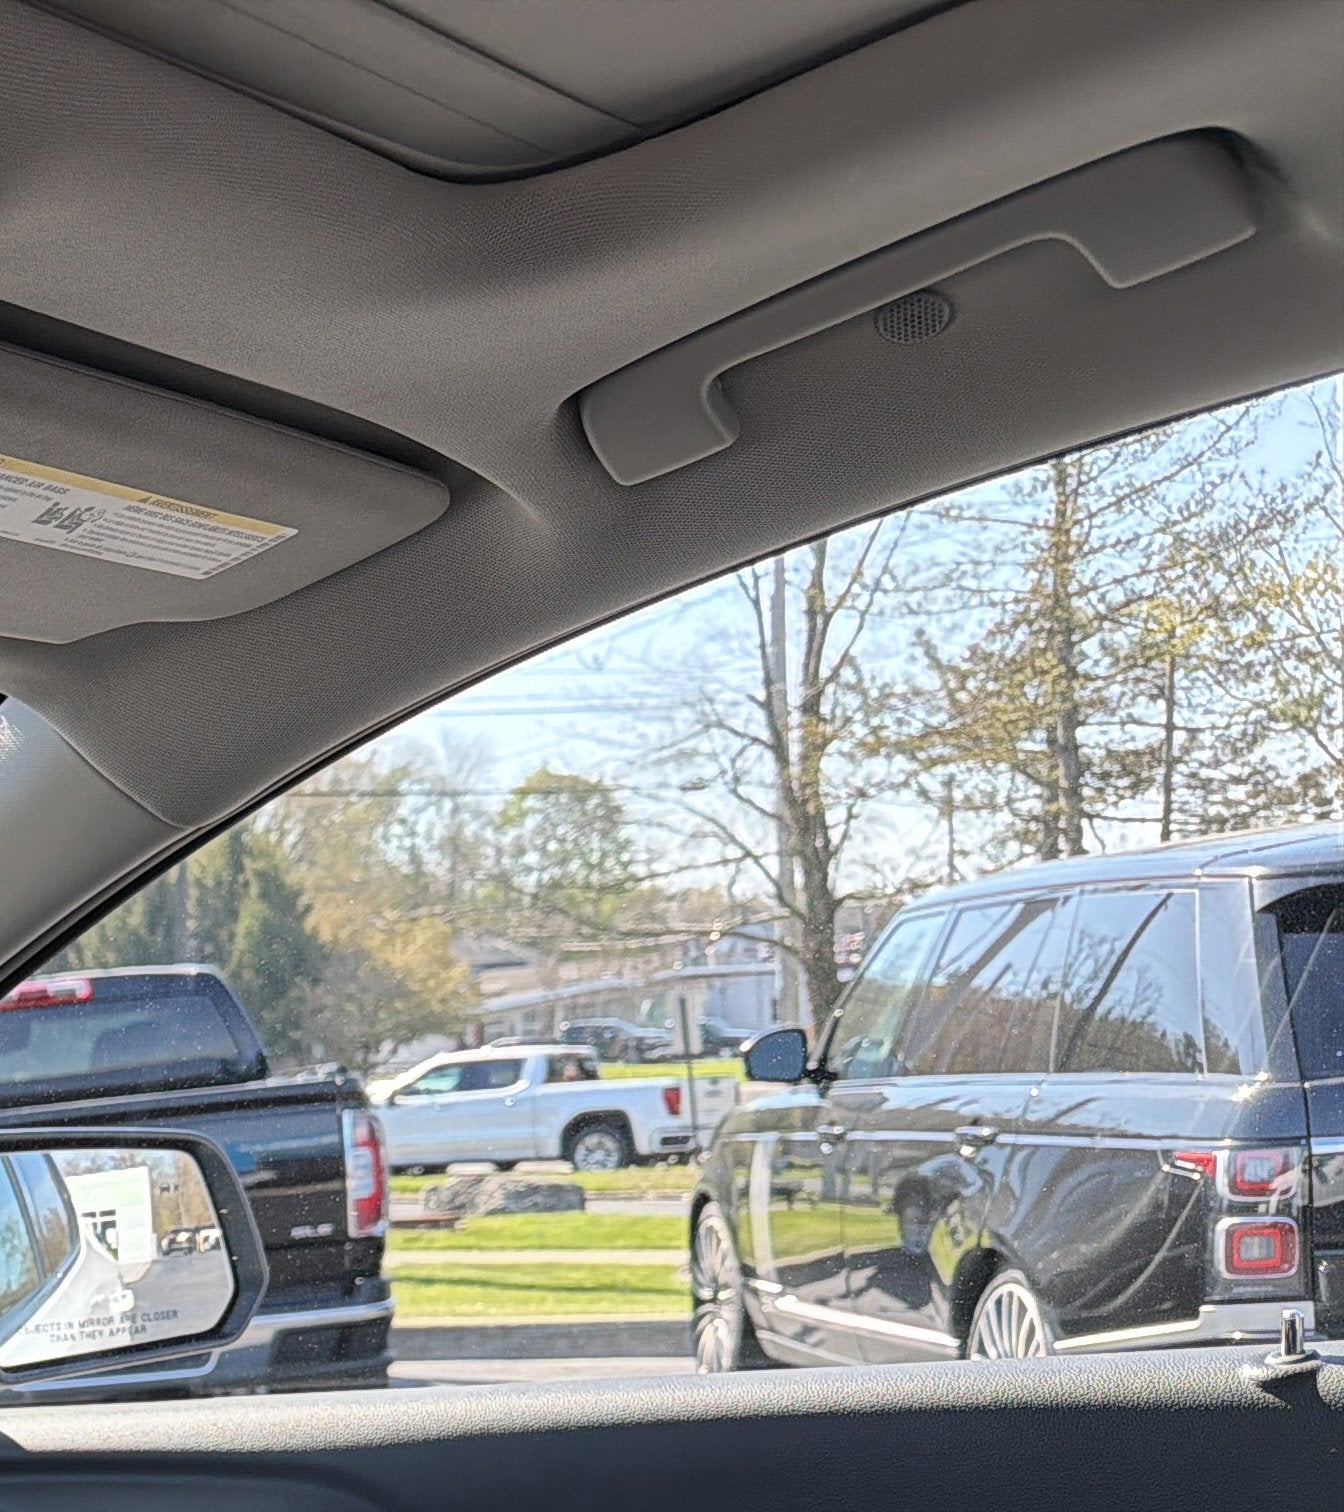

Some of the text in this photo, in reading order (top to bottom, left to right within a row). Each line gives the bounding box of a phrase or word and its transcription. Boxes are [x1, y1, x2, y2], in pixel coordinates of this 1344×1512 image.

[25, 479, 45, 489] AIR
[78, 1315, 115, 1329] MIRROR
[141, 1309, 179, 1322] CLOSER
